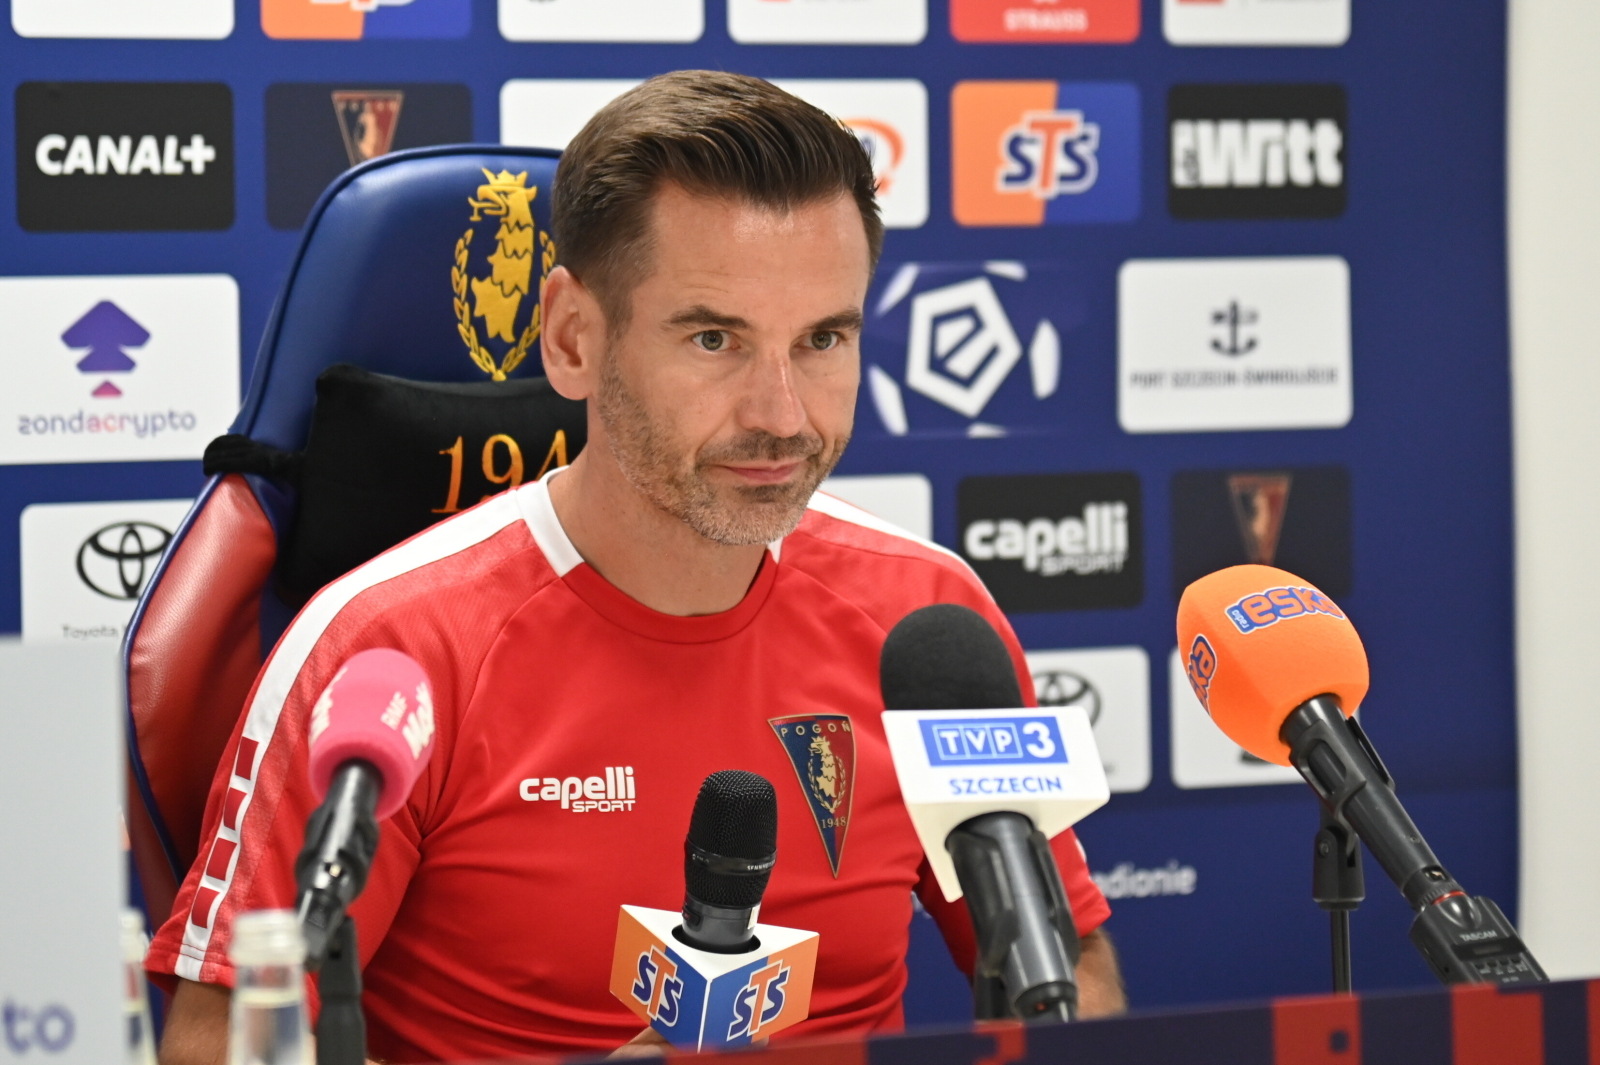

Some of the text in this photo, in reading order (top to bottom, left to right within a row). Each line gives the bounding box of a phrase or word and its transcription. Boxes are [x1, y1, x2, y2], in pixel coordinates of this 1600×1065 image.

[35, 134, 216, 175] CANAL+
[997, 111, 1100, 197] STS
[18, 409, 196, 438] zondacrypto
[964, 502, 1128, 572] capelli
[1040, 554, 1127, 577] SPORT
[1231, 608, 1250, 629] radio
[63, 624, 119, 641] Toyota
[780, 720, 851, 738] POGOŃ
[519, 766, 636, 809] capelli
[949, 777, 1063, 795] SZCZECIN
[572, 800, 636, 813] SPORT
[821, 817, 847, 829] 1948
[1459, 930, 1498, 942] TASCAM
[631, 944, 684, 1027] STS
[726, 959, 791, 1042] STS
